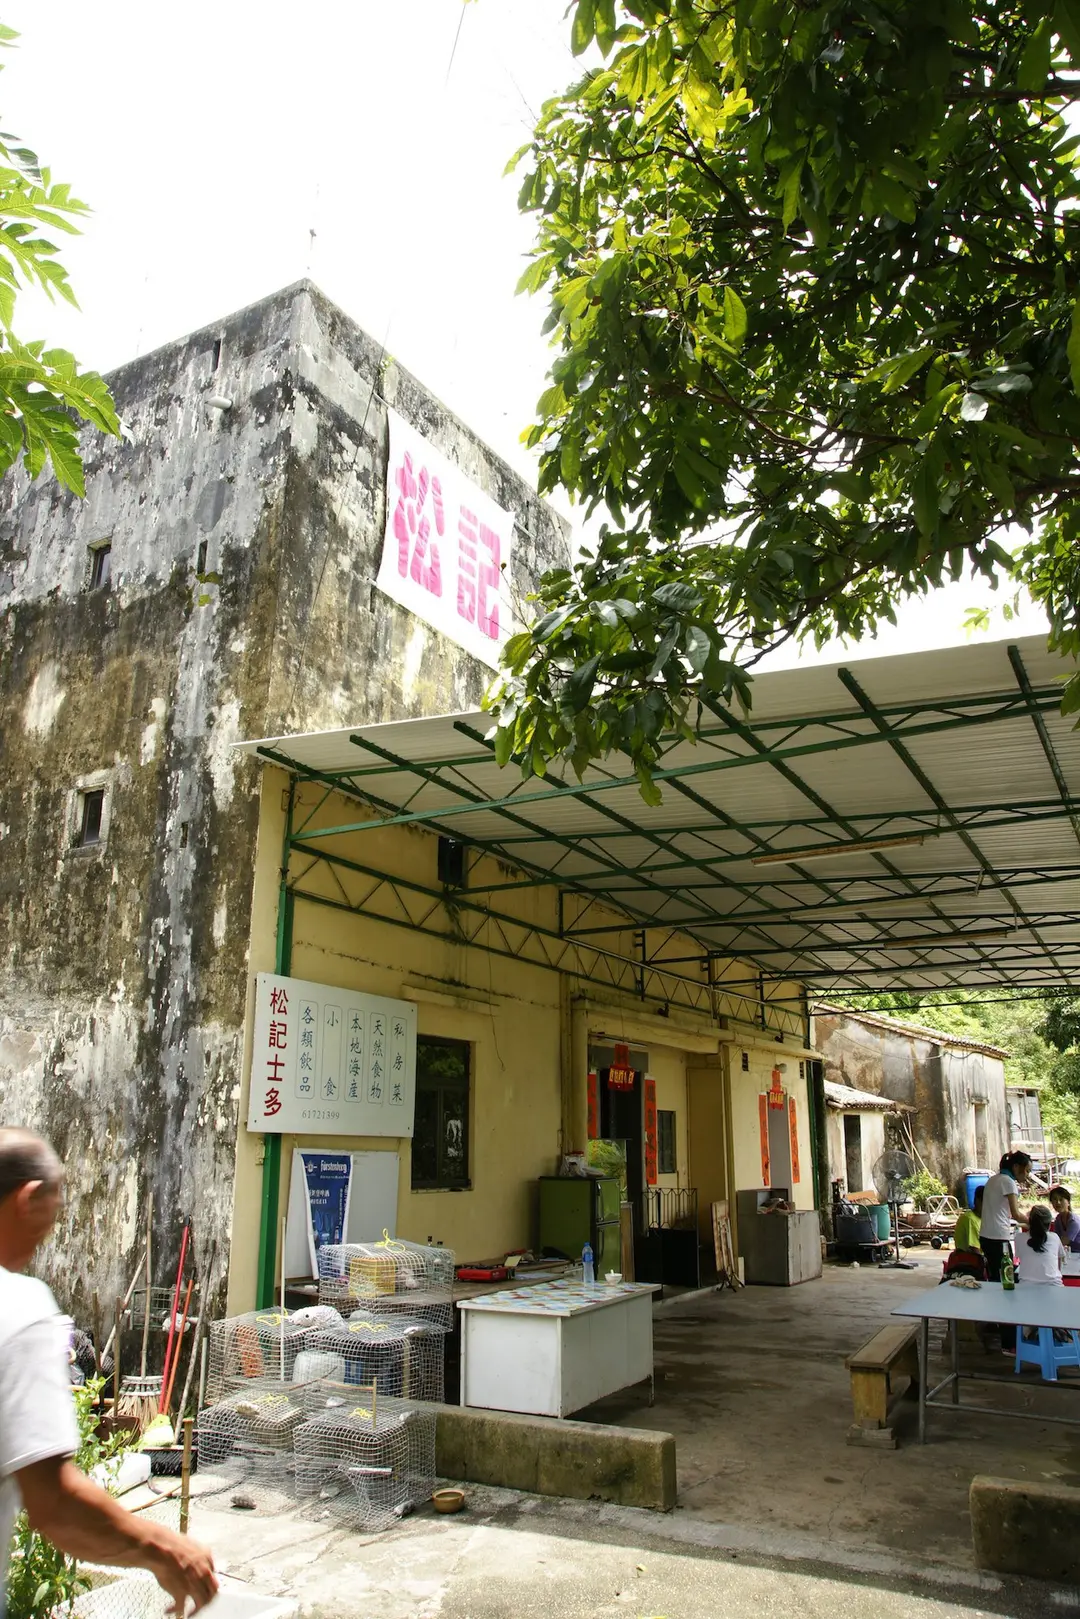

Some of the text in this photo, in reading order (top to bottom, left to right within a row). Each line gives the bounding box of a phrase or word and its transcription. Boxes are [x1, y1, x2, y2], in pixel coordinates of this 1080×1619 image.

[393, 450, 500, 640] 松記
[264, 987, 288, 1117] 松記士多
[300, 1006, 315, 1091] 各類飲品
[324, 1010, 338, 1096] 小食
[371, 1019, 384, 1099] 天然食物
[392, 1023, 404, 1102] 私房菜
[302, 1109, 340, 1120] 61721399
